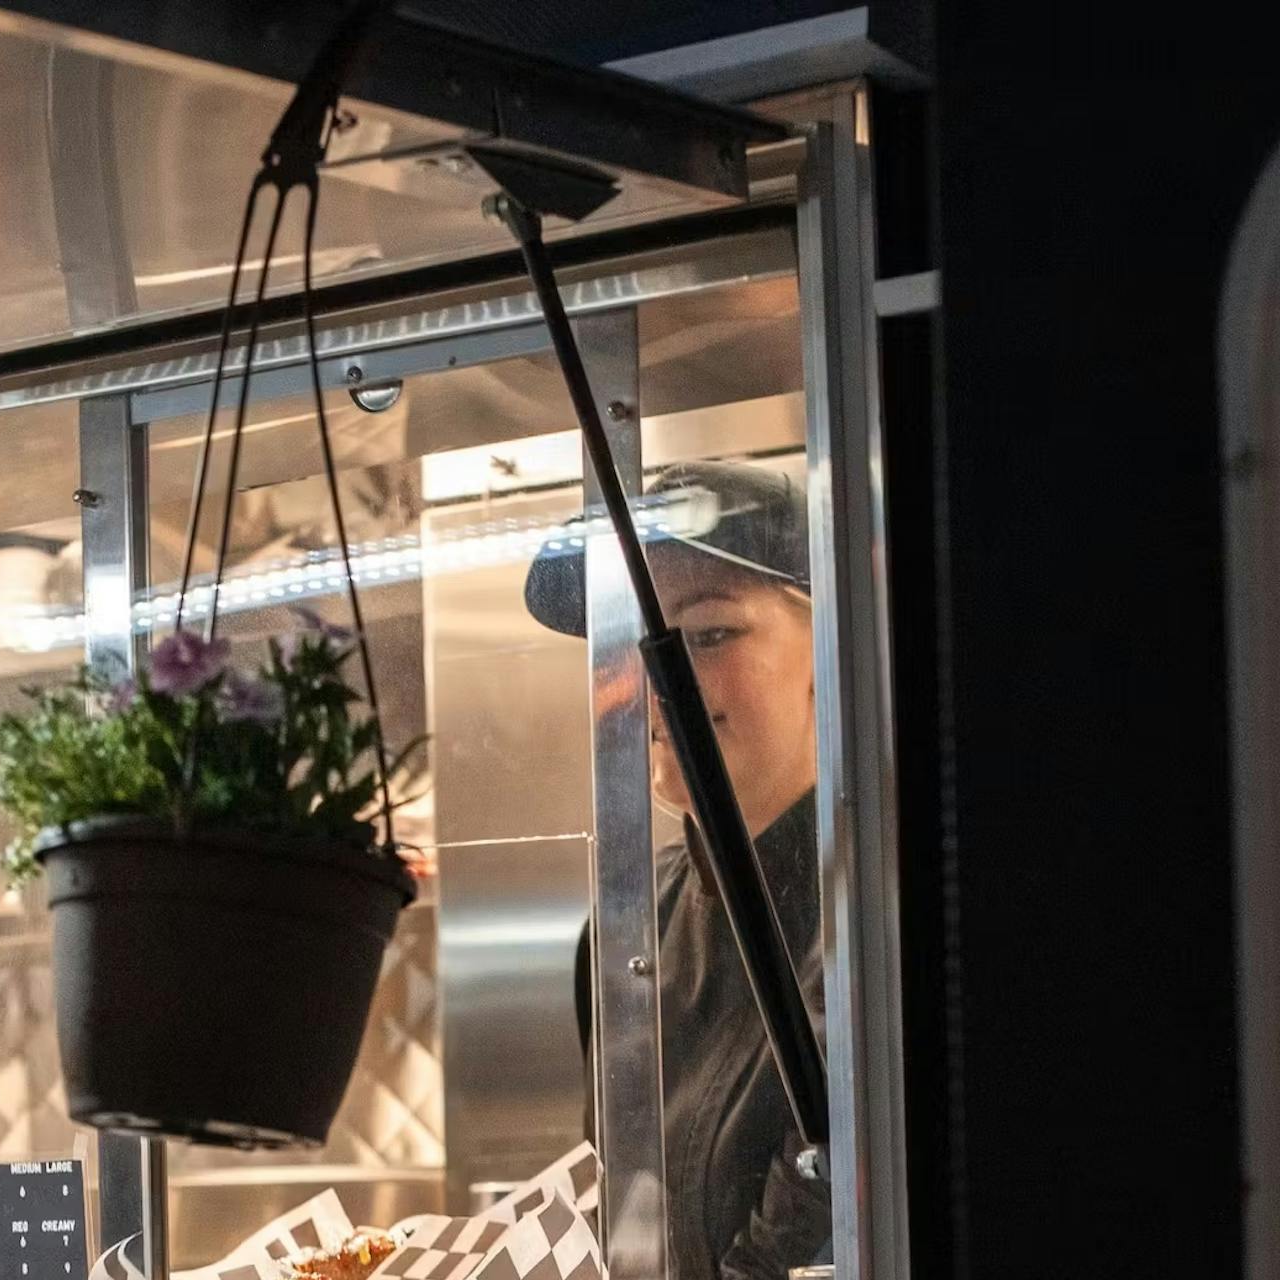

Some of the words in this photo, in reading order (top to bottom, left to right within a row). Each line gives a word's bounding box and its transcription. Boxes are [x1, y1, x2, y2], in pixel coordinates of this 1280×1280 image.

[11, 1162, 41, 1174] MEDIUM
[46, 1161, 73, 1172] LARGE
[41, 1220, 76, 1232] CREAMY
